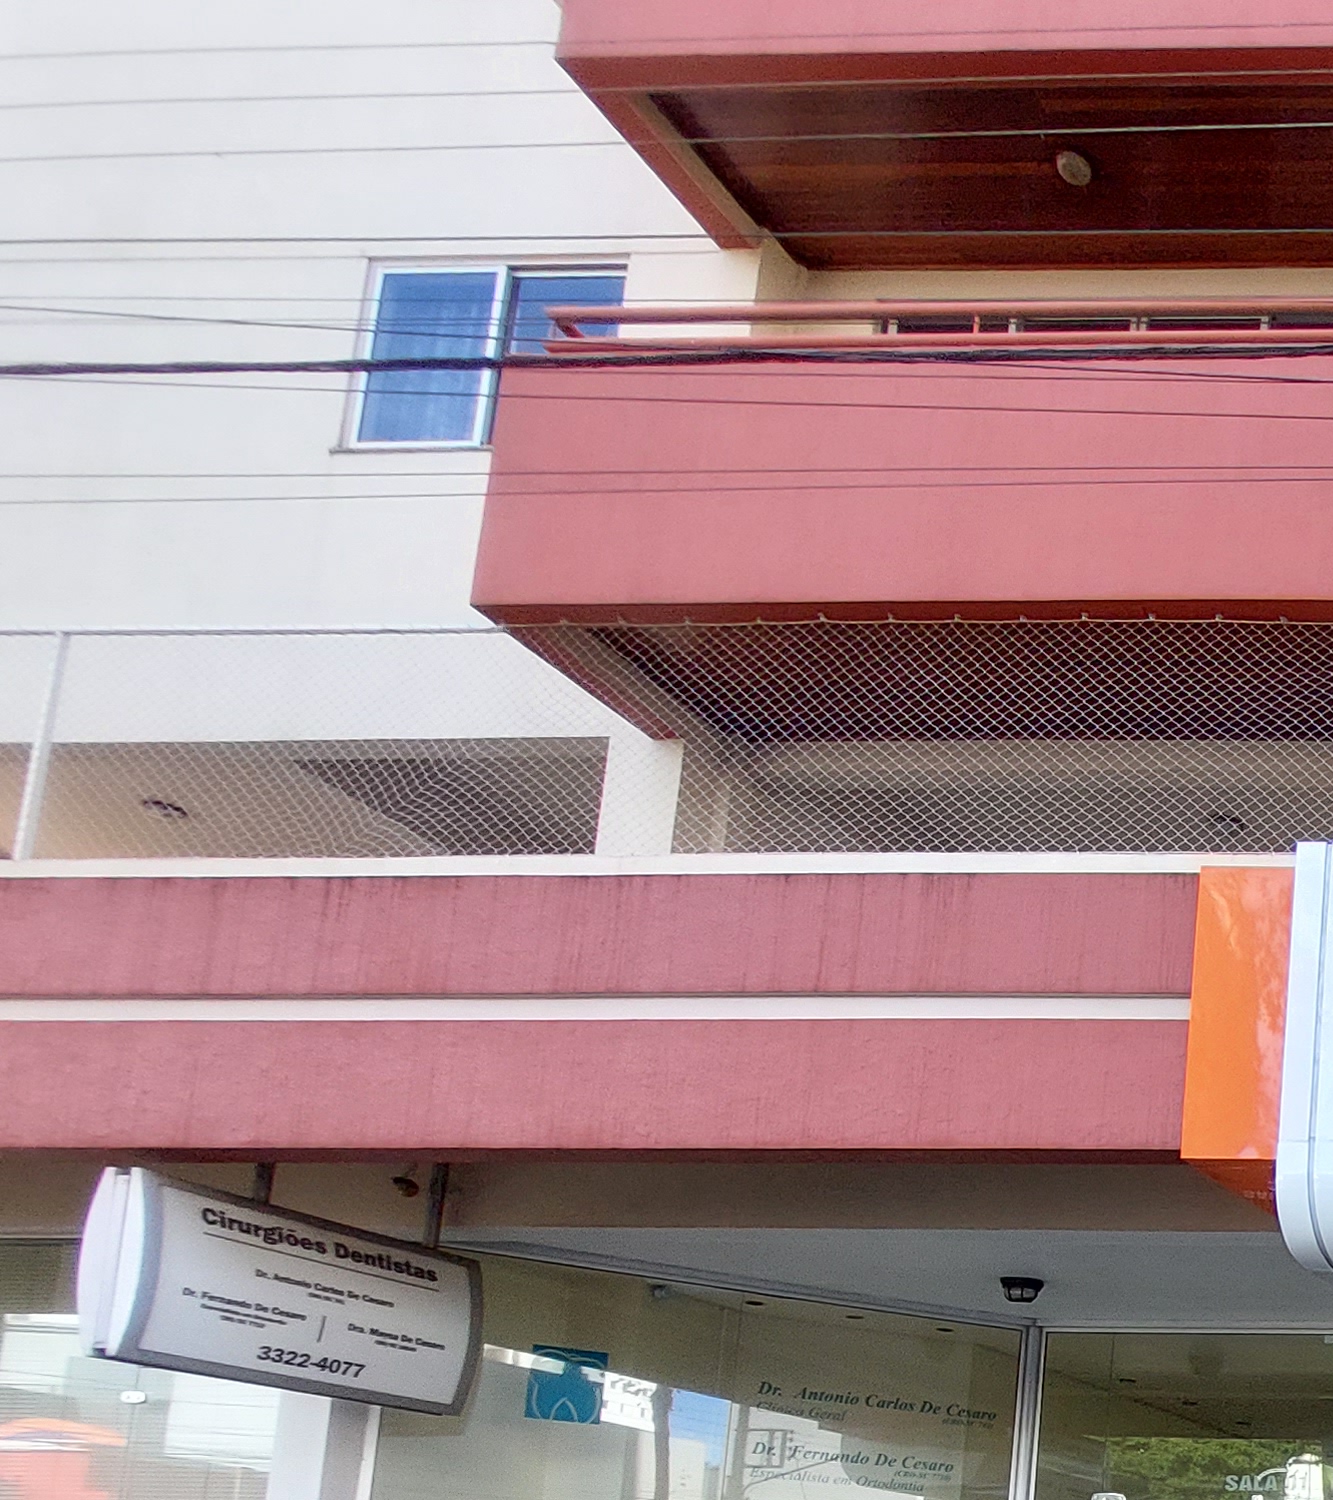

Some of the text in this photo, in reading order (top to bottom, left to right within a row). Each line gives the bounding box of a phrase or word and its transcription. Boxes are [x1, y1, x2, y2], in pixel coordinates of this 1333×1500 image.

[202, 1207, 439, 1282] Cirurgiões Dentistas
[257, 1346, 366, 1378] 3322-4077
[758, 1381, 997, 1422] Dr. Antonio Carlos De Cesaro
[752, 1442, 954, 1473] Dr. Fernando De Cesaro
[750, 1467, 831, 1485] Especialista
[856, 1475, 925, 1492] Ortodontia
[1224, 1475, 1277, 1492] SALA
